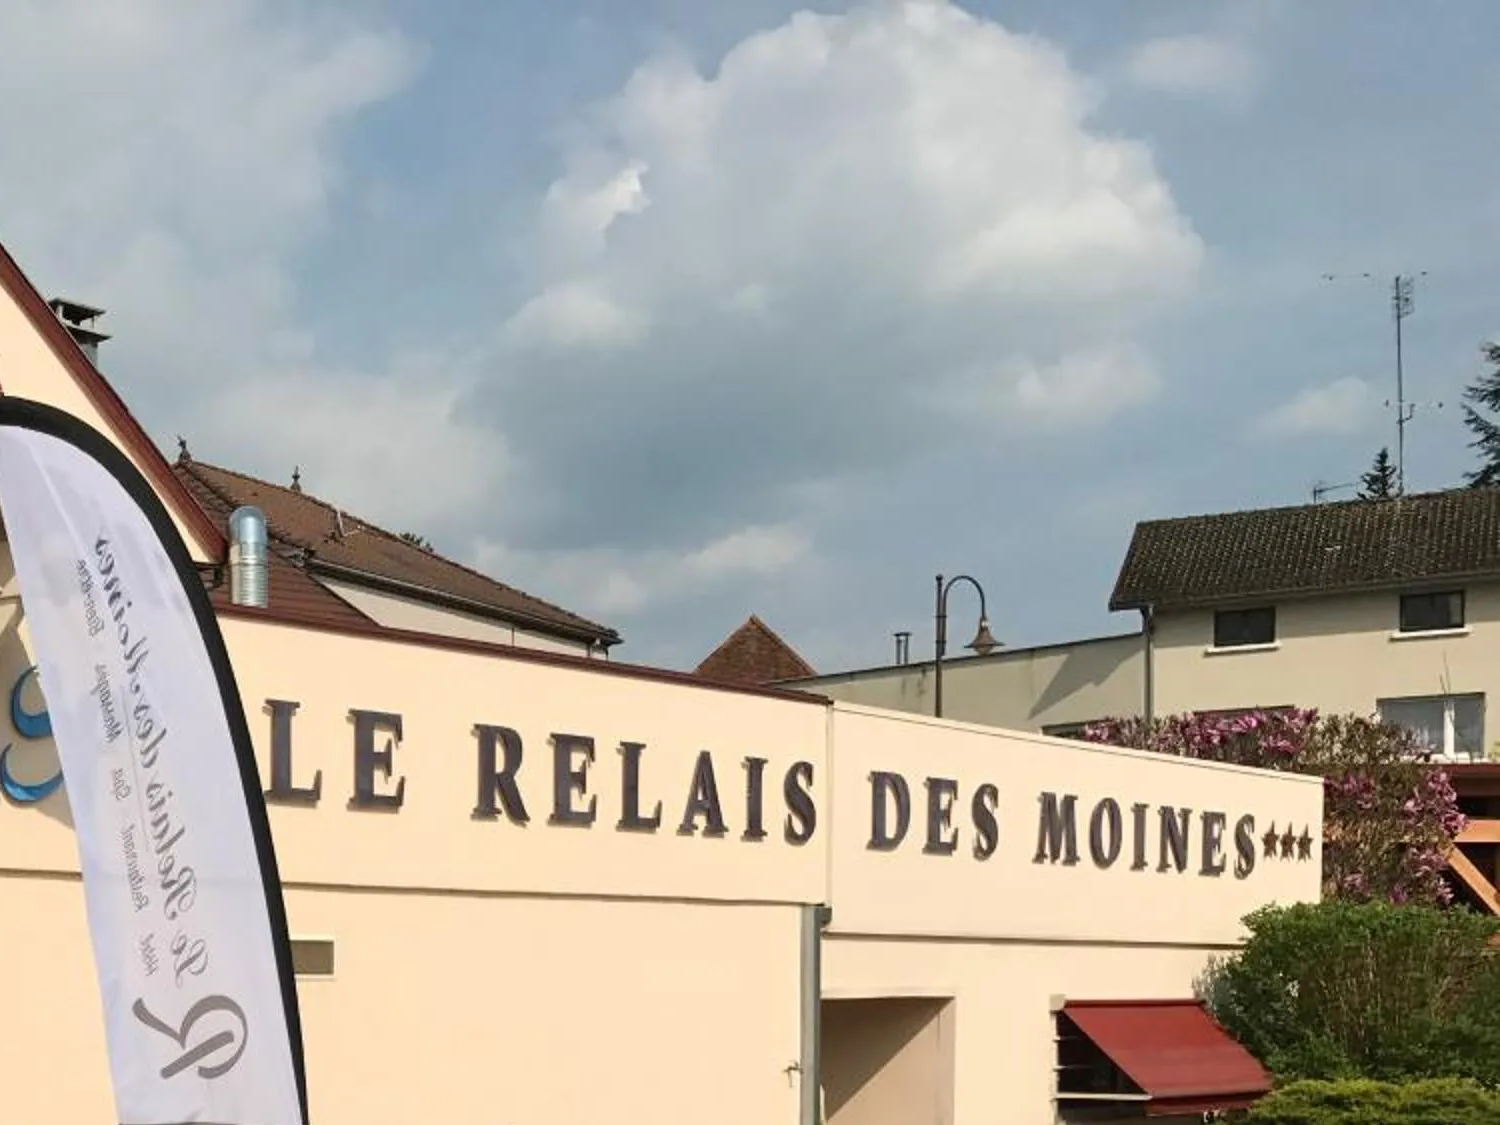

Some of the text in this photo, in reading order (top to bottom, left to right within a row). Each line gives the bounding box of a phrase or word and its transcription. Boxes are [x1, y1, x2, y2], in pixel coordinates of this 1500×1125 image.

[263, 698, 1258, 880] LE RELAIS DES MOINES
